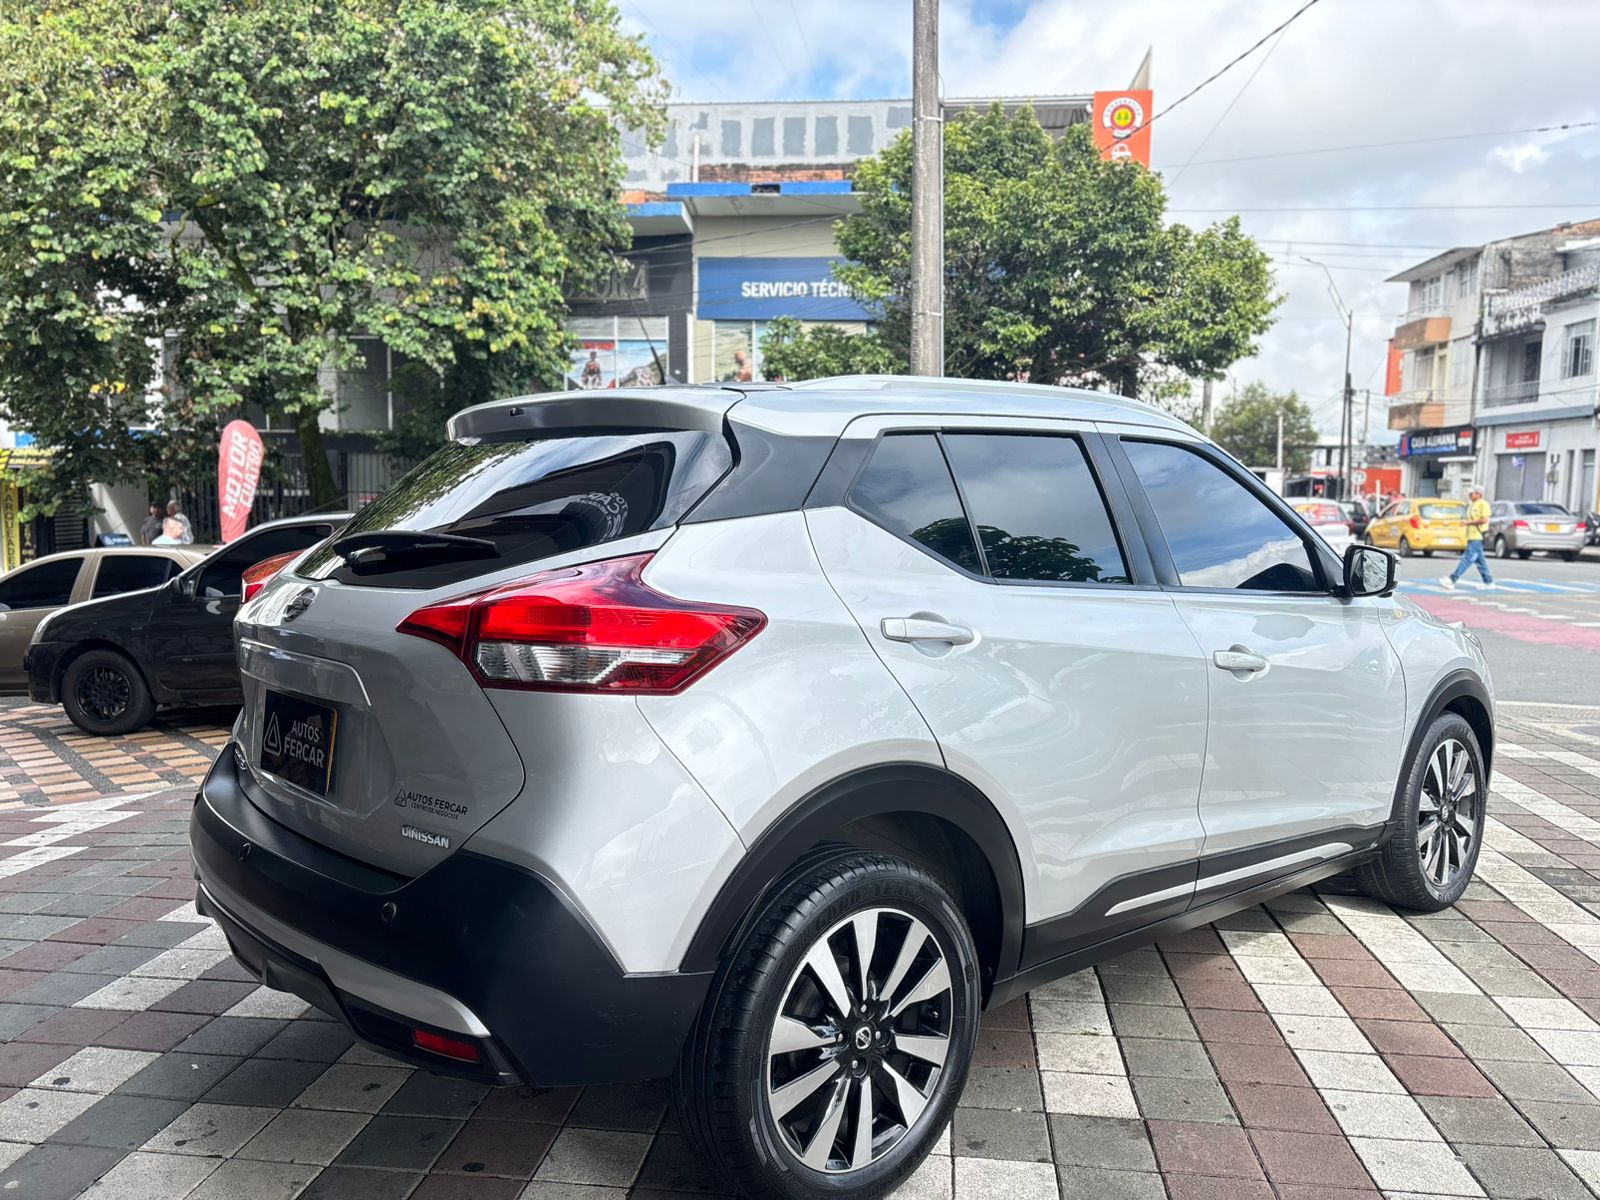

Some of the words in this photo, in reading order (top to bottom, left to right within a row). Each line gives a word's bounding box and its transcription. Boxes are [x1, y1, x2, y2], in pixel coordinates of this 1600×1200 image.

[741, 281, 808, 298] SERVICIO
[1411, 436, 1426, 448] CASA
[1426, 433, 1456, 447] ALEMANA
[222, 430, 249, 519] MOTOR
[291, 720, 320, 743] AUTOS
[284, 735, 325, 768] FERCAR
[406, 792, 433, 806] AUTOS
[434, 798, 468, 815] FERCAR
